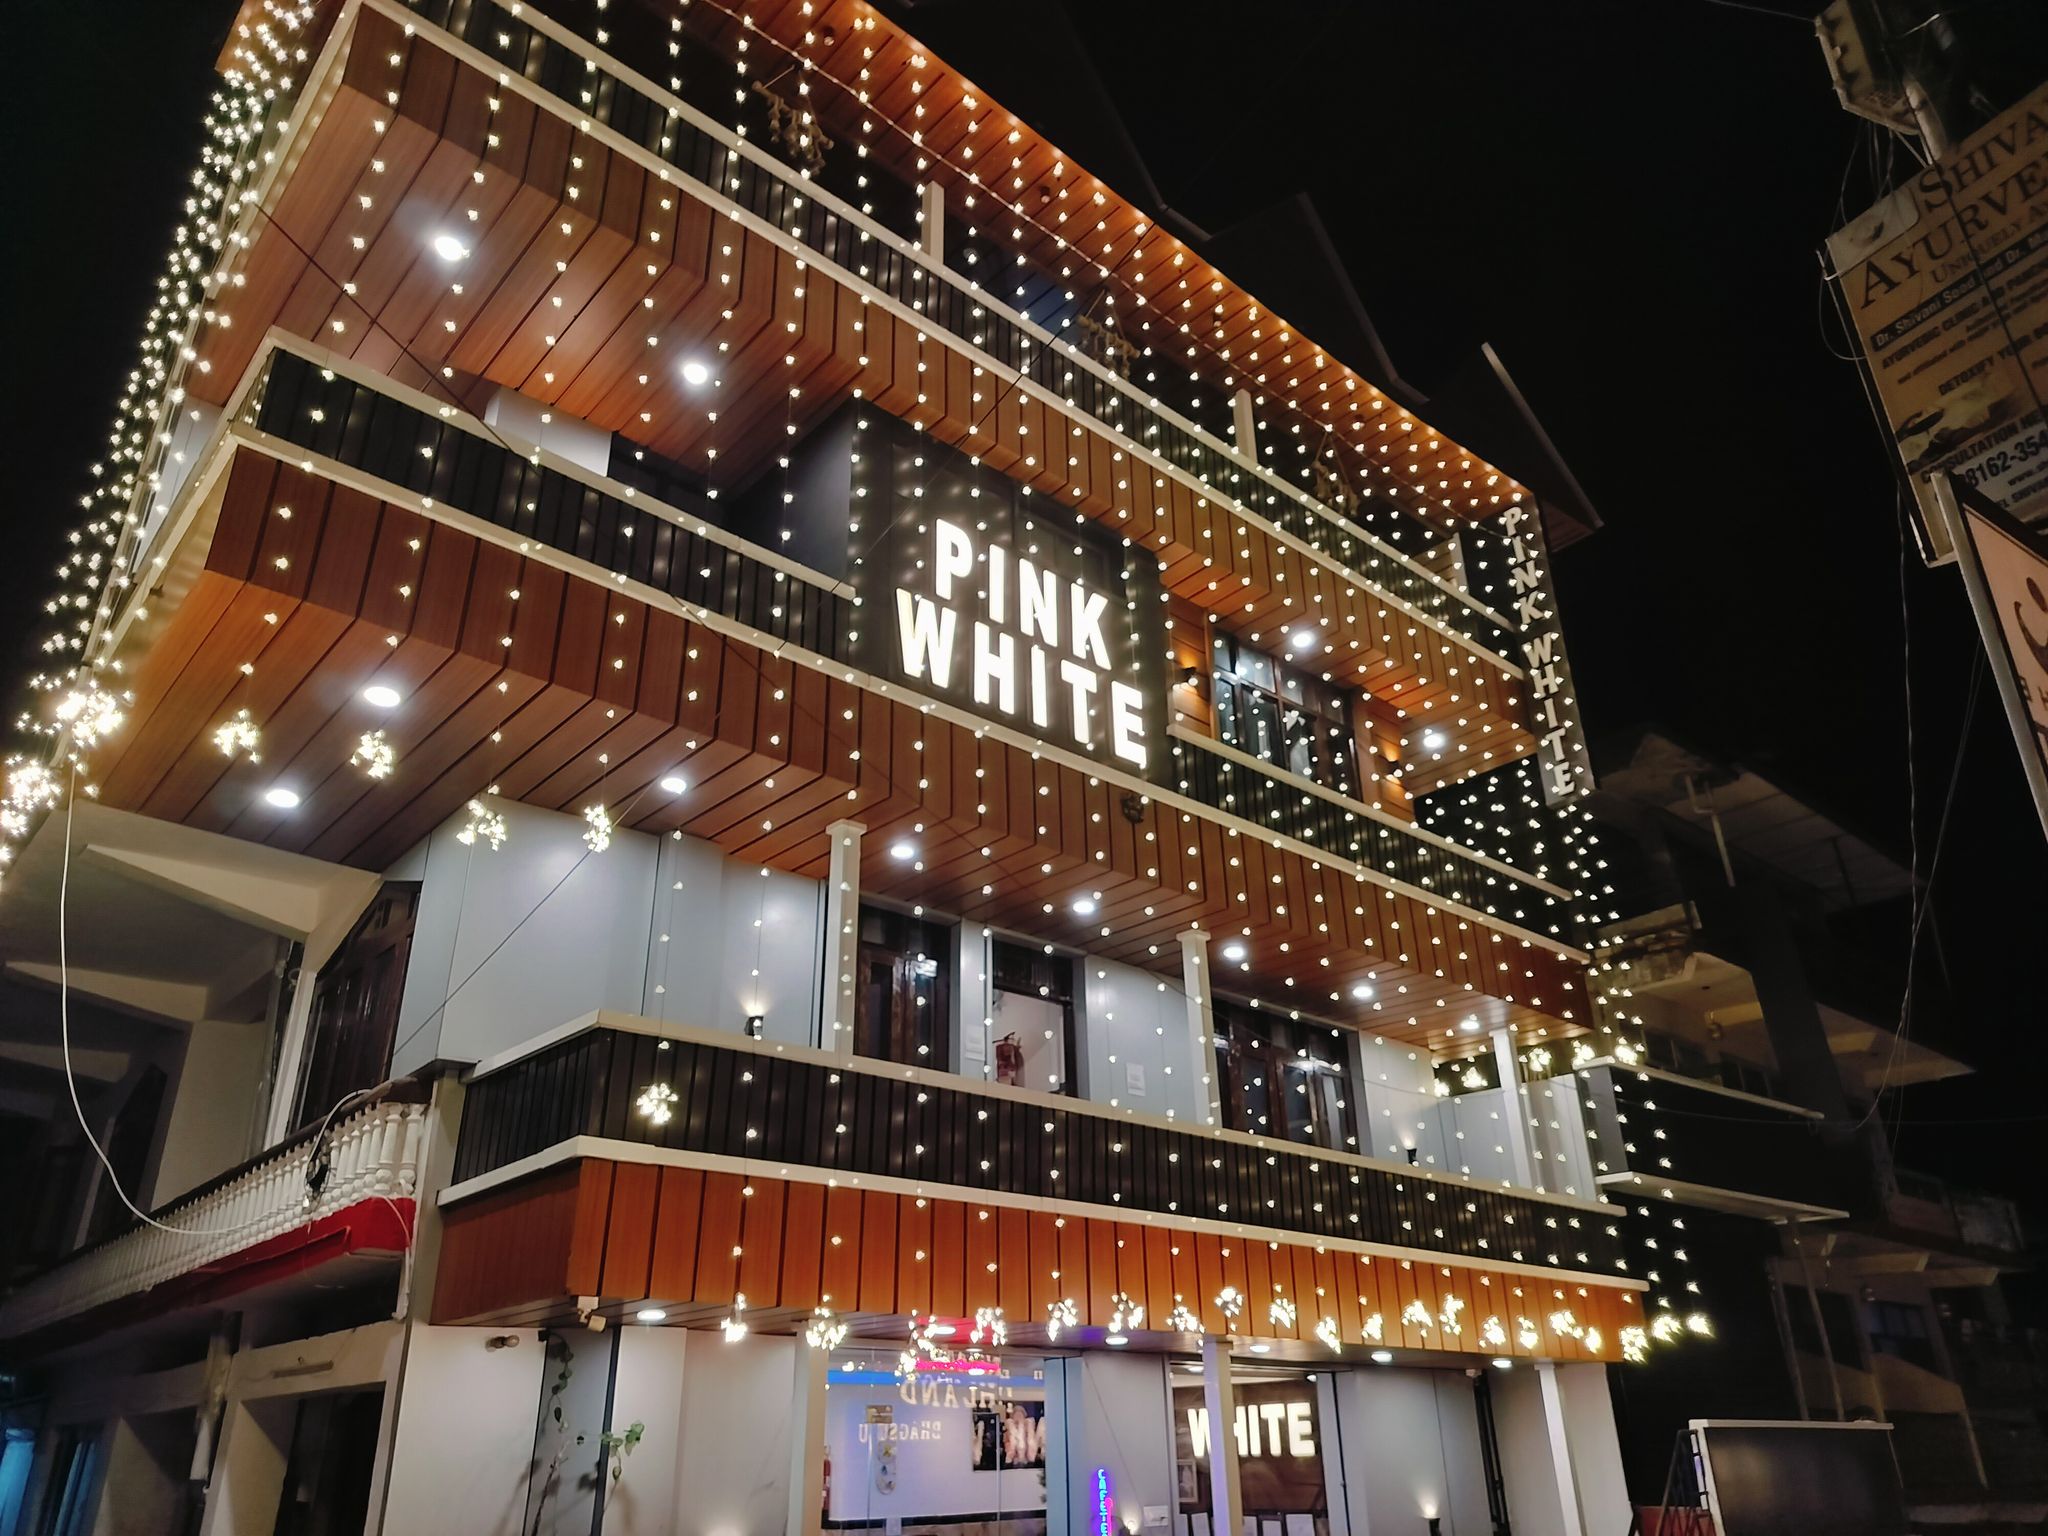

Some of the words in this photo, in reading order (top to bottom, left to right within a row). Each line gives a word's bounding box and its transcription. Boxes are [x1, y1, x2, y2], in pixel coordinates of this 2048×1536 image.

[1861, 152, 2048, 309] AYURVE
[1919, 98, 2048, 213] SHIVA
[936, 518, 1112, 671] PINK
[1503, 506, 1545, 625] PINK
[896, 588, 1147, 768] WHITE
[1524, 631, 1576, 797] WHITE
[1097, 1468, 1109, 1536] CAFETE
